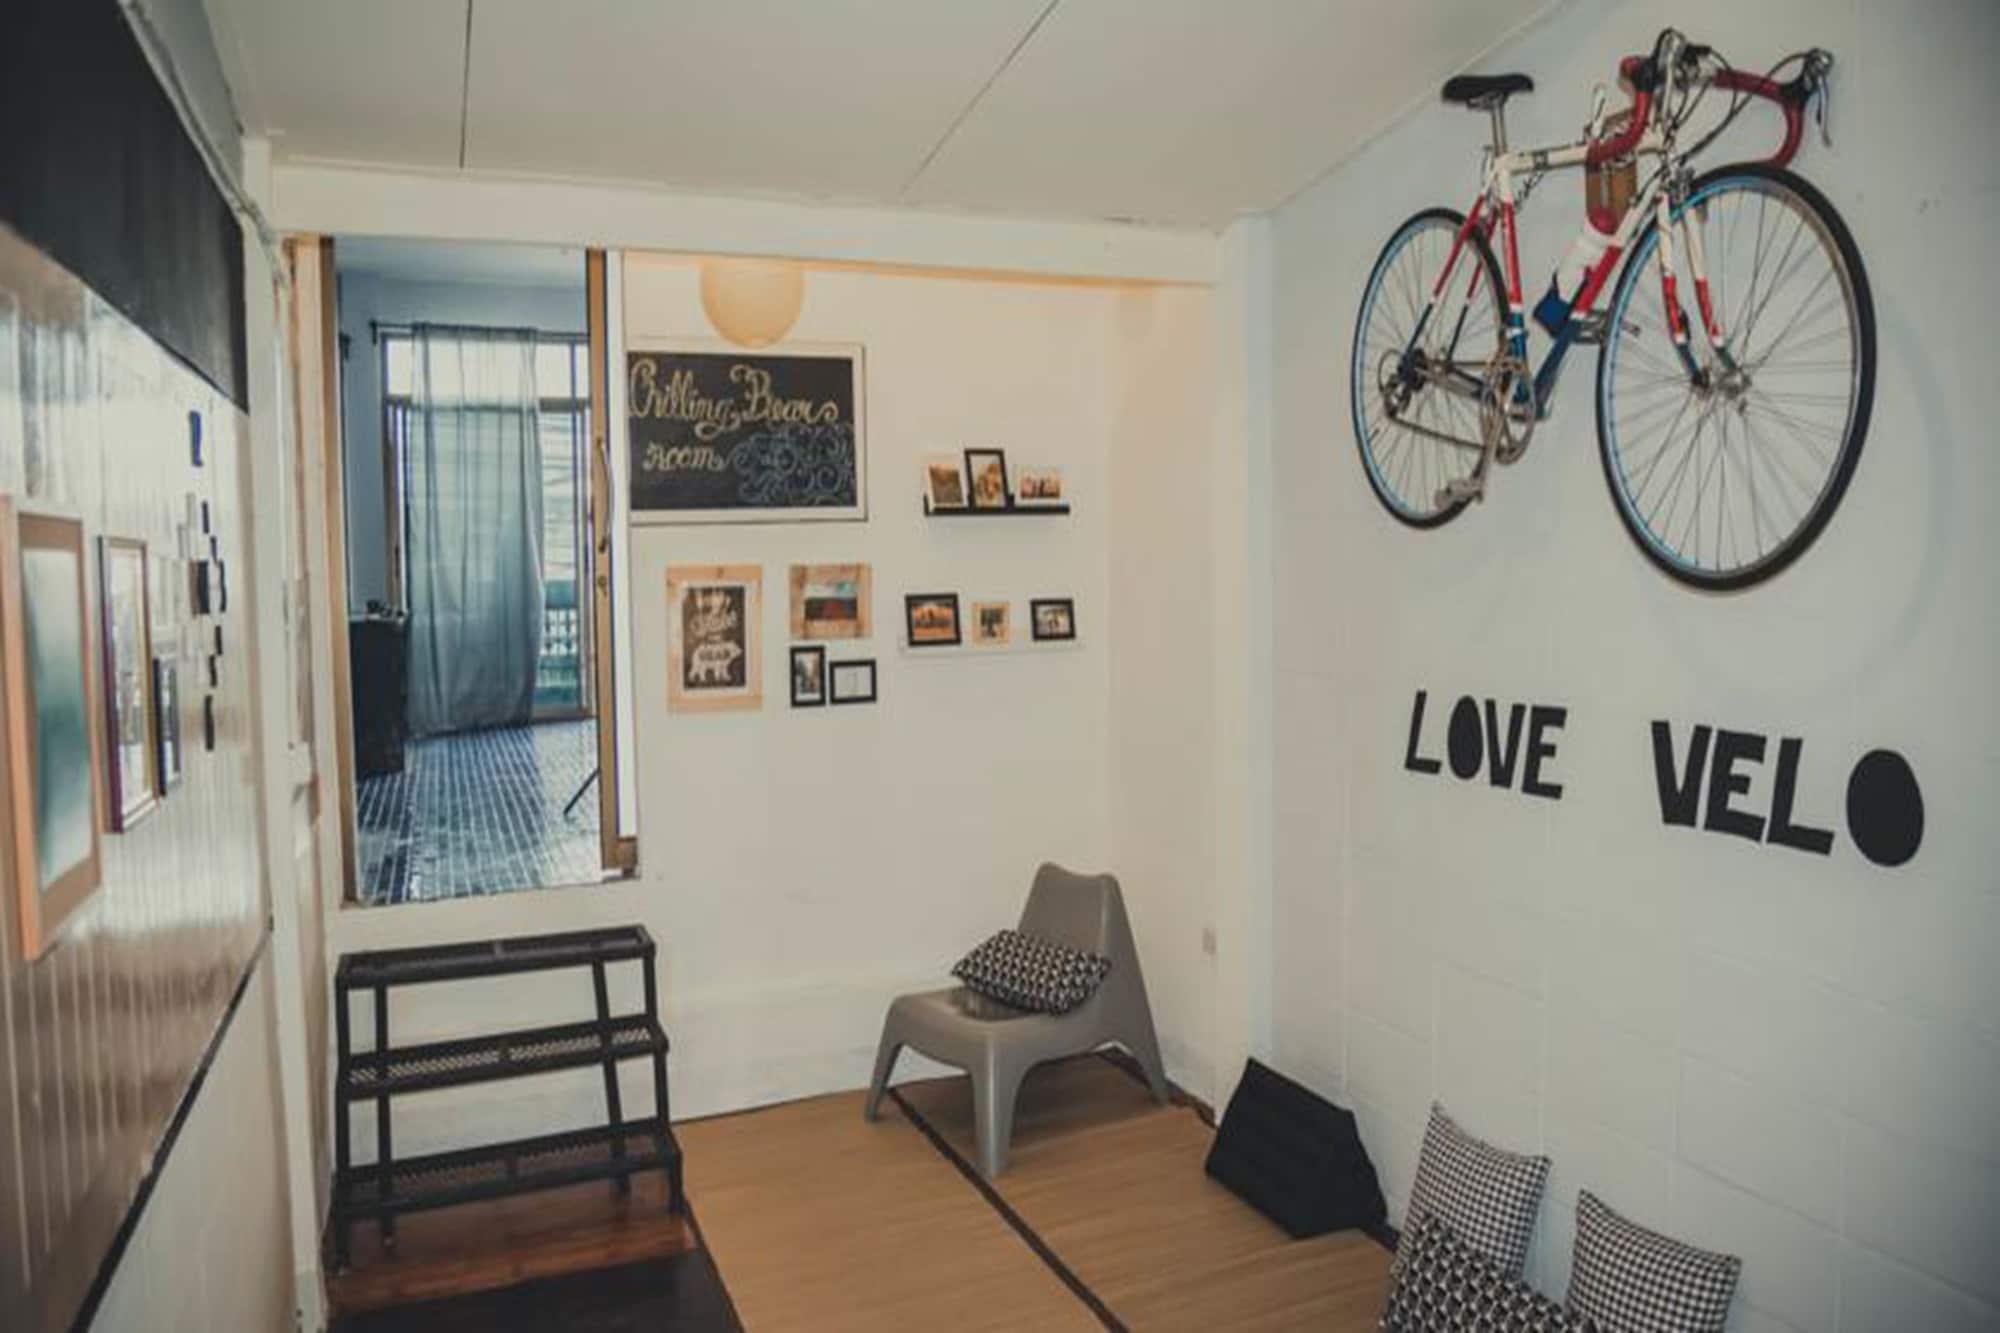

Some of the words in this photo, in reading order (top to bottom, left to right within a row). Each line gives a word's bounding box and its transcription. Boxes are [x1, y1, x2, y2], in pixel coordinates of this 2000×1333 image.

[629, 358, 741, 440] Chilling
[730, 364, 839, 424] Bears
[1403, 690, 1568, 800] LOVE
[1650, 719, 1925, 868] VELO
